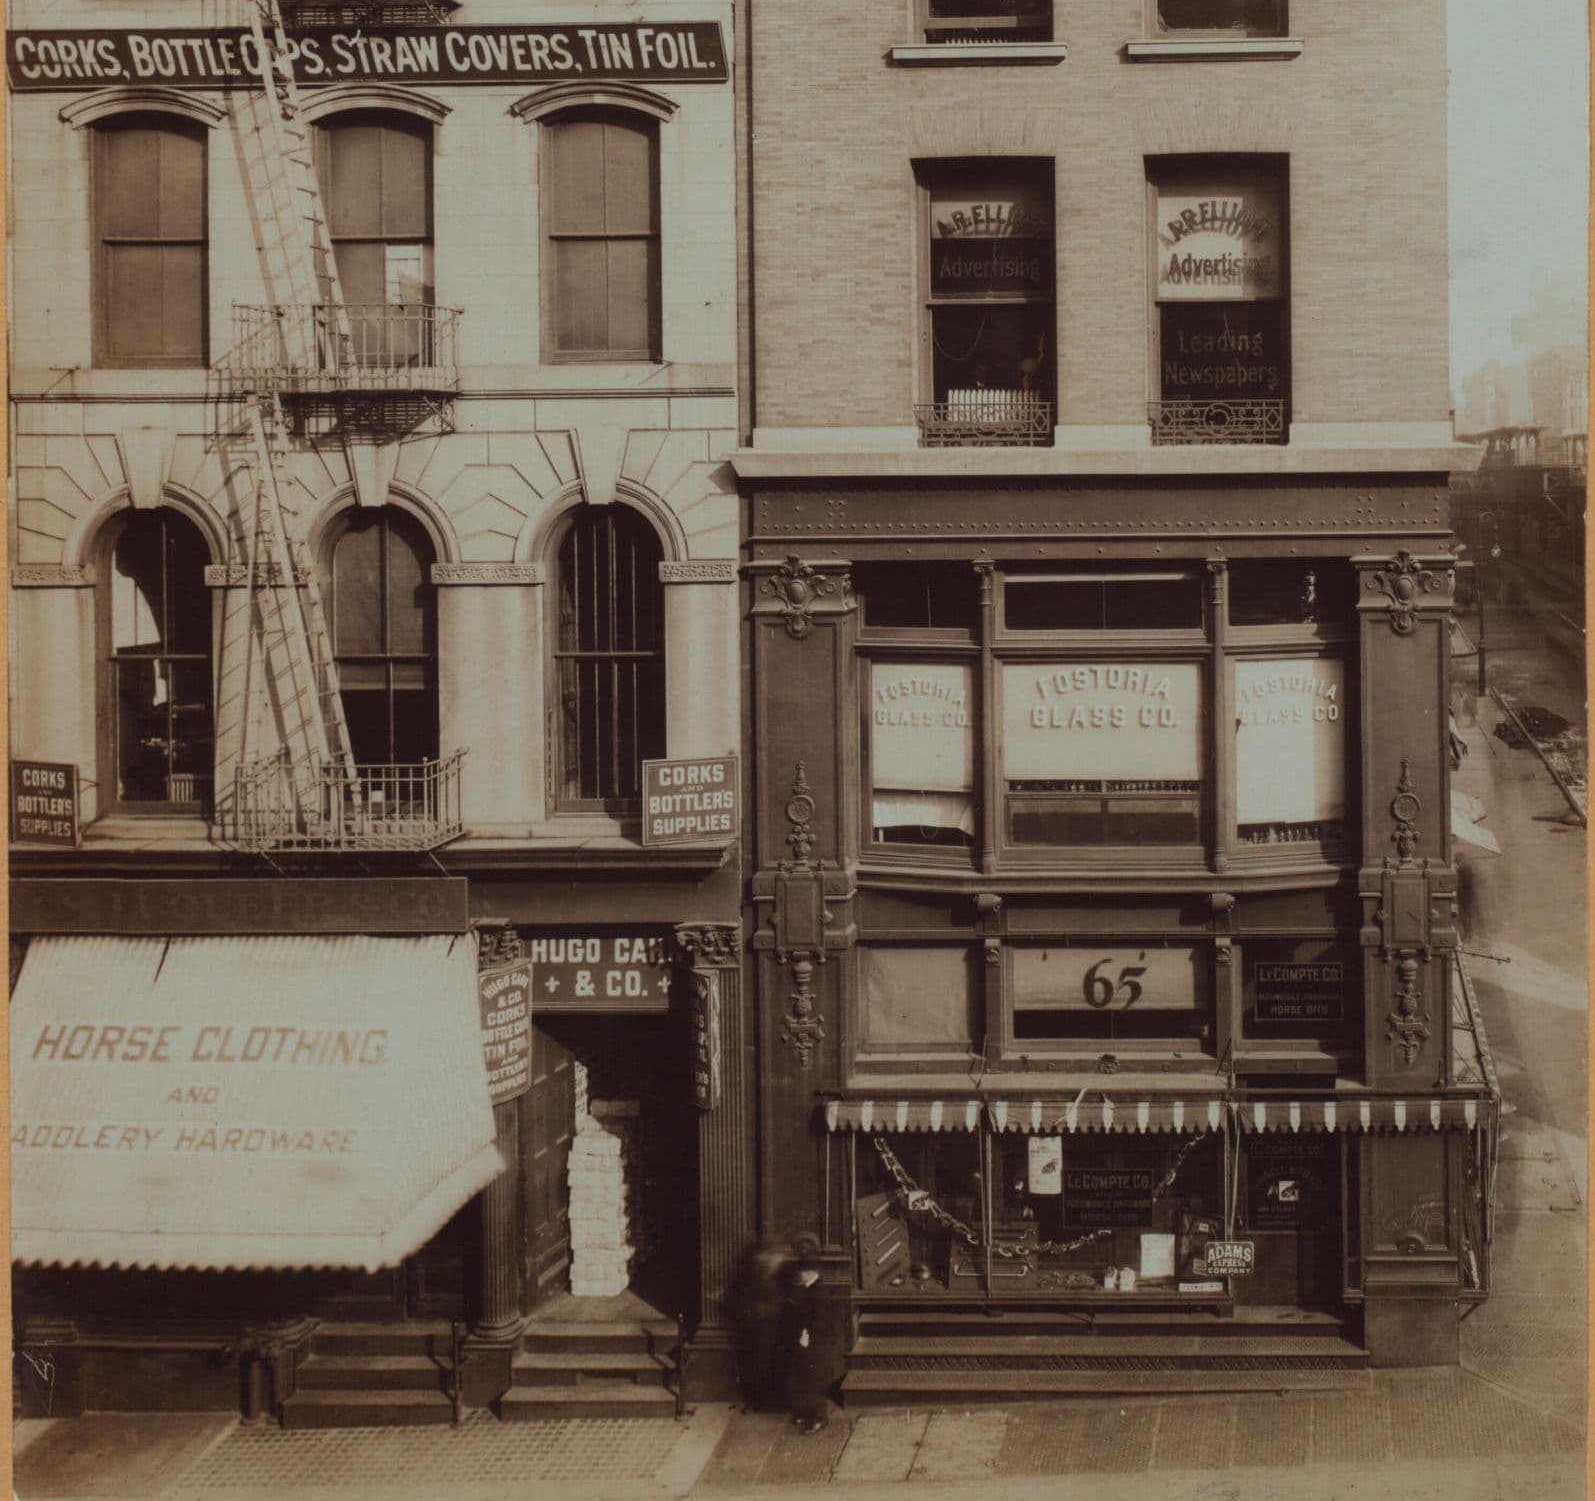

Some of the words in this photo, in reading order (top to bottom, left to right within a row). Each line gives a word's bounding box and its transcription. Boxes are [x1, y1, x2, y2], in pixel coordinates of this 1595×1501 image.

[15, 36, 130, 80] CORKS,
[128, 35, 241, 77] BOTTLE
[331, 33, 440, 74] STRAW
[445, 30, 583, 74] COVERS,
[578, 29, 633, 69] TIN
[638, 28, 716, 69] FOIL.
[939, 253, 1041, 281] Advertising
[1178, 329, 1263, 356] Leading
[1164, 360, 1278, 388] Newspapers
[1036, 667, 1171, 701] FOSTORIA
[874, 709, 934, 727] GLASS
[1030, 705, 1128, 729] GLASS
[22, 768, 66, 789] CORKS
[658, 764, 725, 787] CORKS
[680, 785, 704, 793] AND
[649, 789, 734, 814] BOTTLER'S
[20, 817, 71, 837] SUPPLIES
[652, 814, 731, 836] SUPPLIES
[532, 938, 601, 963] HUGO
[482, 974, 510, 999] HUGO
[575, 970, 596, 996] &
[606, 970, 648, 996] CO.
[1082, 958, 1148, 1011] 65
[487, 1002, 526, 1026] CORKS
[31, 1024, 183, 1062] HORSE
[166, 1086, 222, 1106] AND
[1207, 1244, 1251, 1263] ADAMS
[1213, 1258, 1246, 1267] EXPRESS
[1207, 1267, 1251, 1275] COMPANY
